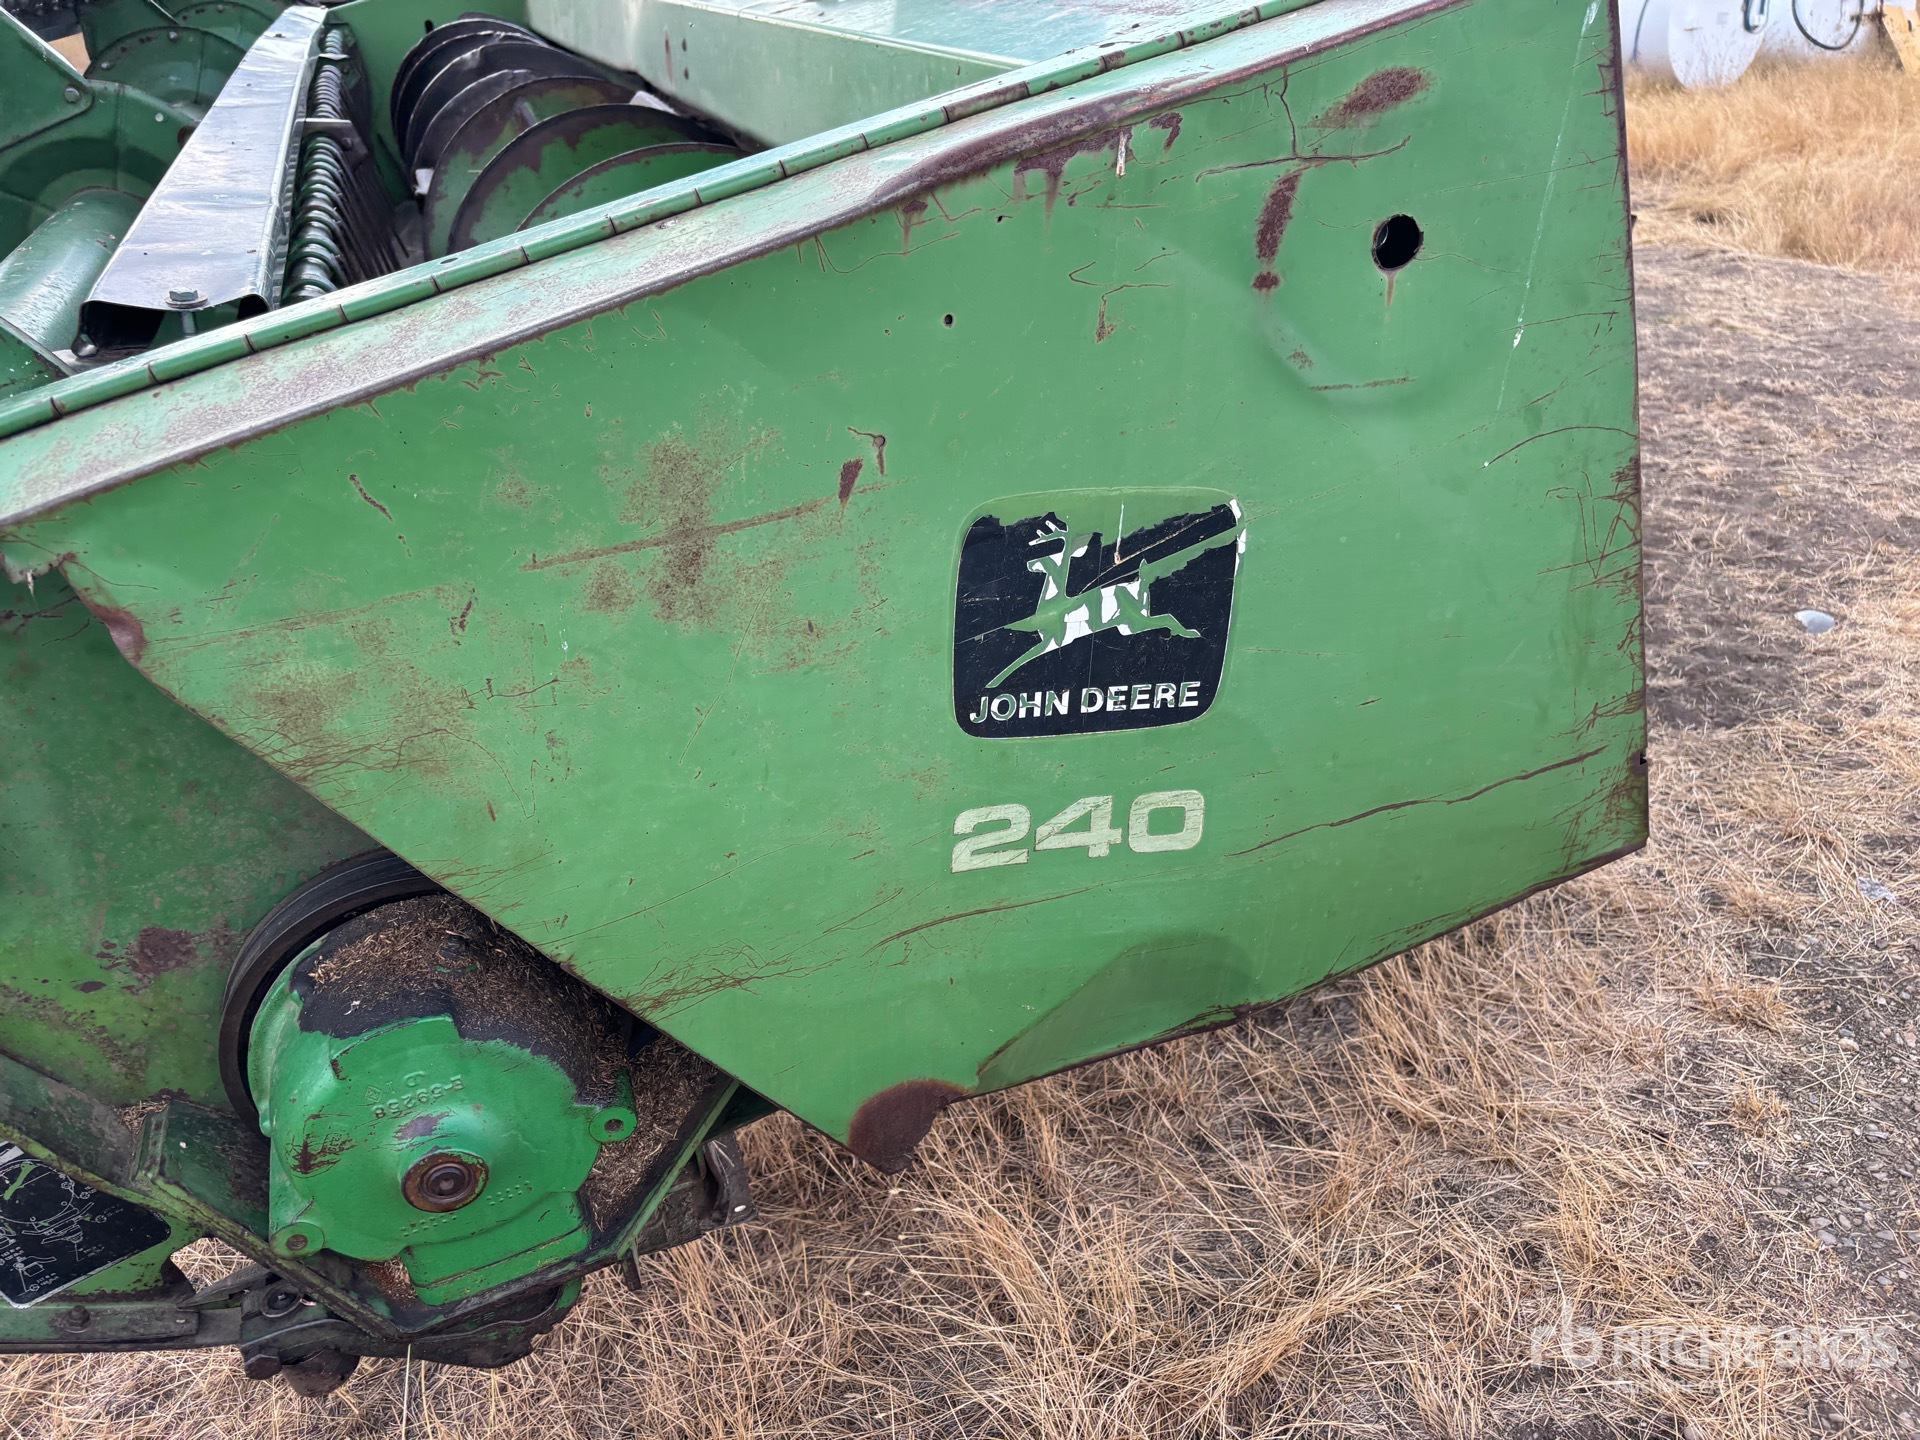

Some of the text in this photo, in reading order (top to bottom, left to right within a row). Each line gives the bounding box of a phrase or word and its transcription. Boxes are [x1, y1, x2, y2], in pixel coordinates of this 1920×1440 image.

[968, 682, 1202, 724] JOHN DEERE
[951, 790, 1205, 874] 240
